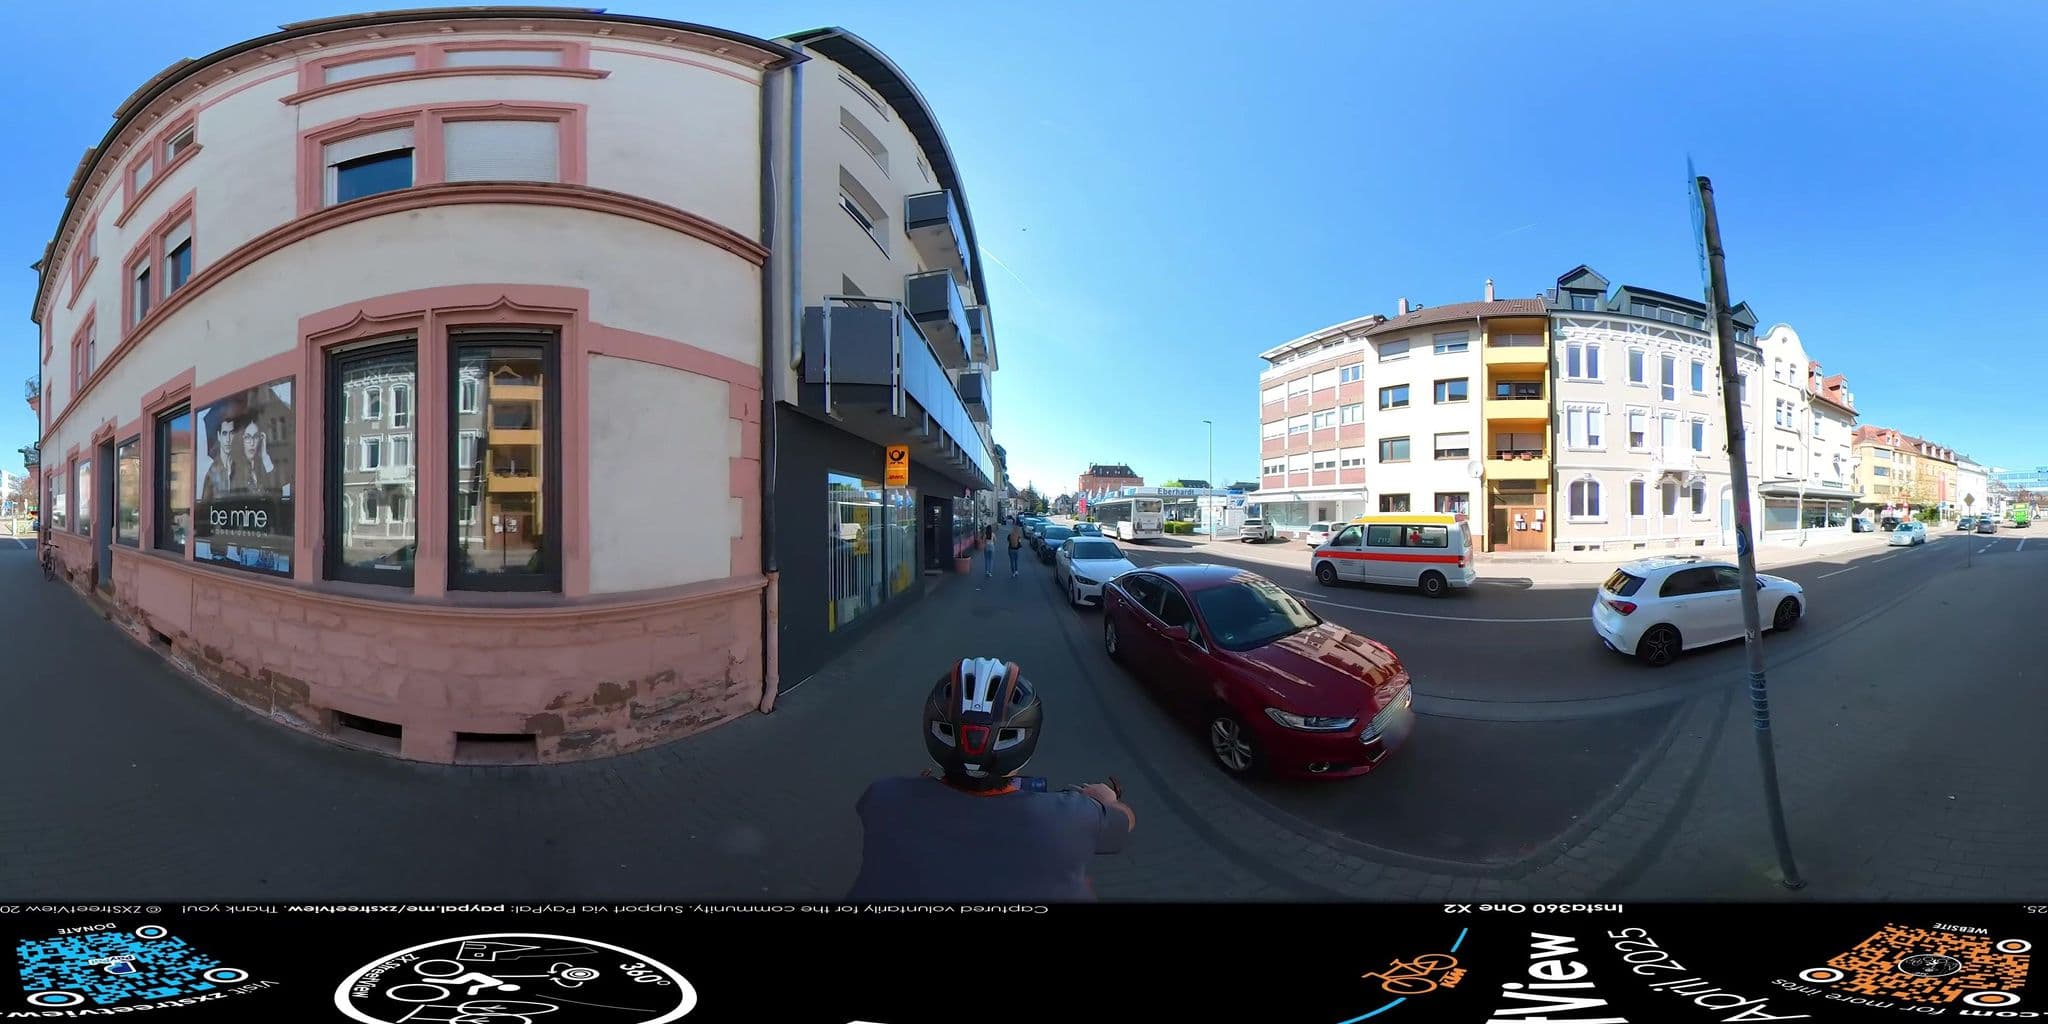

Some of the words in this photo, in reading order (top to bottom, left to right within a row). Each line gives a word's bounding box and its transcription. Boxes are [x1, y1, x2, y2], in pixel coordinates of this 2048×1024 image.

[1157, 487, 1195, 496] Eberhardt
[210, 505, 228, 526] be
[231, 505, 268, 528] mine
